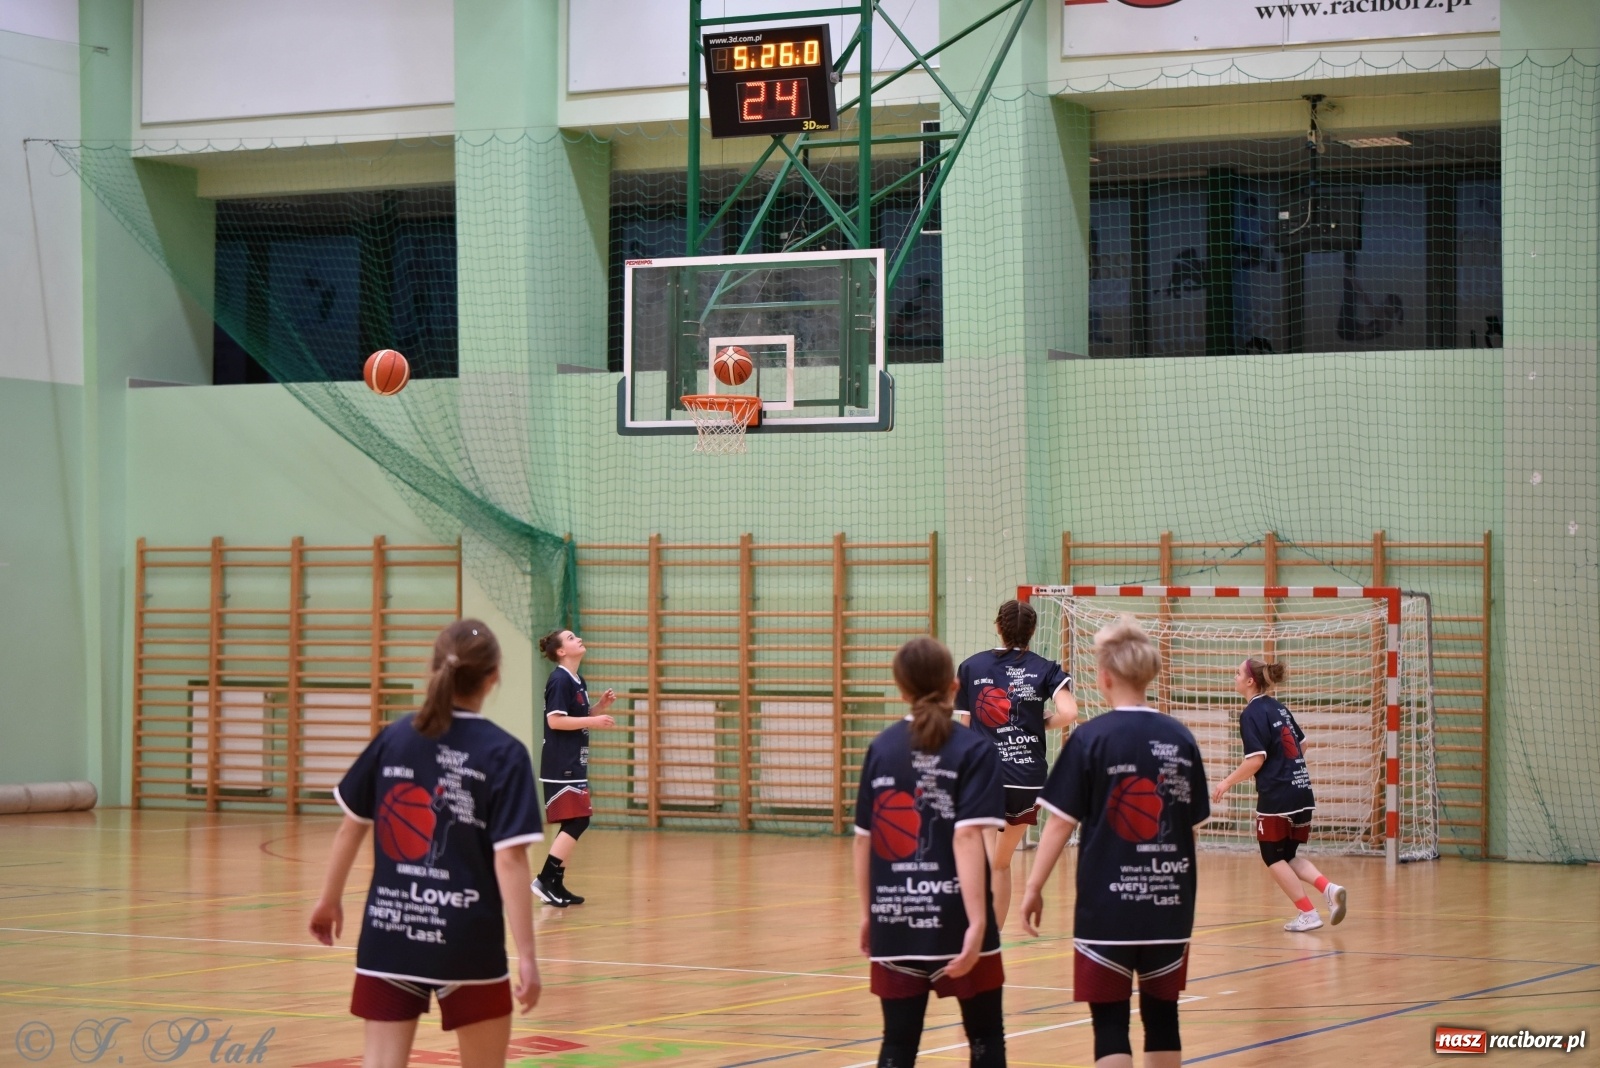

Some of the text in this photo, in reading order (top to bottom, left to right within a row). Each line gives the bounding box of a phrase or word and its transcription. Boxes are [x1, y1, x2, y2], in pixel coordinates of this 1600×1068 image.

[709, 34, 763, 45] www.3d.com.pl
[742, 80, 798, 121] 24
[802, 120, 817, 131] 3D
[1258, 821, 1264, 835] 4
[1120, 864, 1142, 873] What
[876, 885, 897, 893] What
[1109, 882, 1148, 893] every
[377, 886, 400, 898] What
[410, 881, 480, 909] Love?
[404, 902, 439, 916] playing
